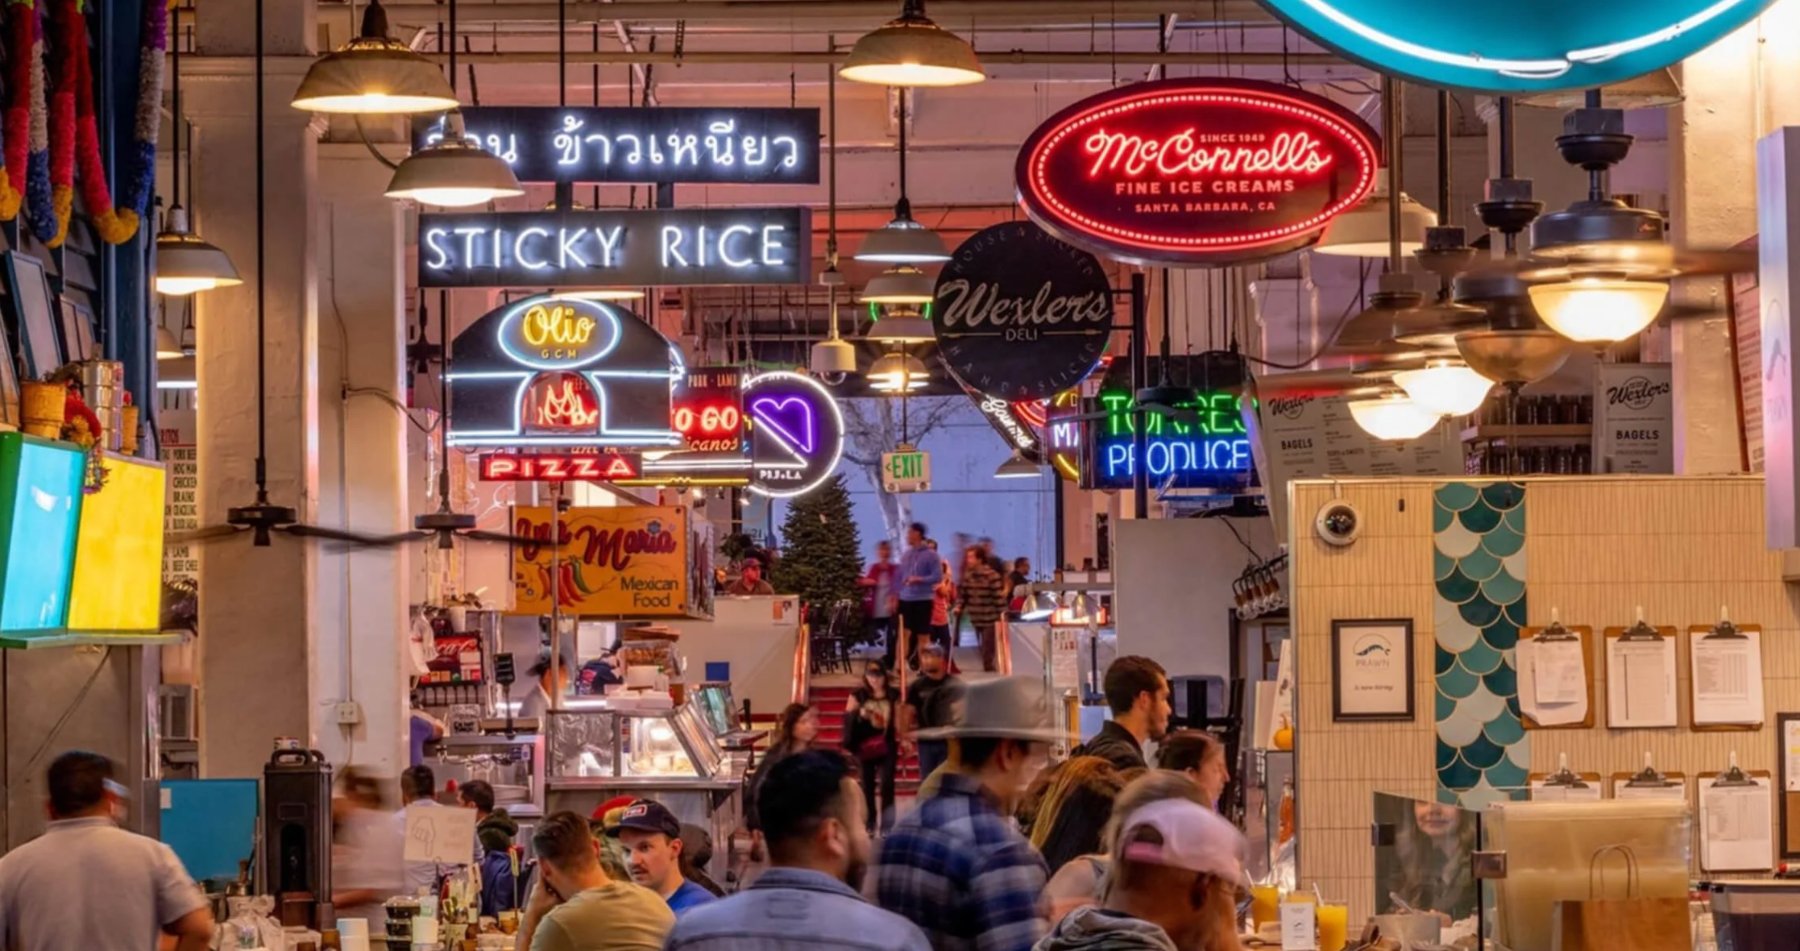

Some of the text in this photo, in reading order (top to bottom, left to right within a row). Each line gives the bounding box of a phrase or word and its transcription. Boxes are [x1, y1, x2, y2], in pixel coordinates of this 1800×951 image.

[553, 114, 798, 167] ข้าวเหนียว
[1199, 133, 1236, 143] SINCE
[1085, 127, 1333, 177] McConnell's
[1115, 178, 1296, 196] FINE ICE CREAMS
[1135, 201, 1276, 213] SANTA BARBARA, CA
[426, 225, 785, 270] STICKY RICE
[523, 304, 597, 346] Olio
[1004, 328, 1039, 342] DELI
[701, 405, 738, 432] GO
[1280, 438, 1313, 450] BAGELS
[1616, 429, 1660, 440] BAGELS
[486, 458, 635, 478] PIZZA
[891, 454, 924, 479] EXIT
[575, 525, 677, 571] Maria
[620, 576, 679, 591] Mexican
[633, 594, 671, 607] Food
